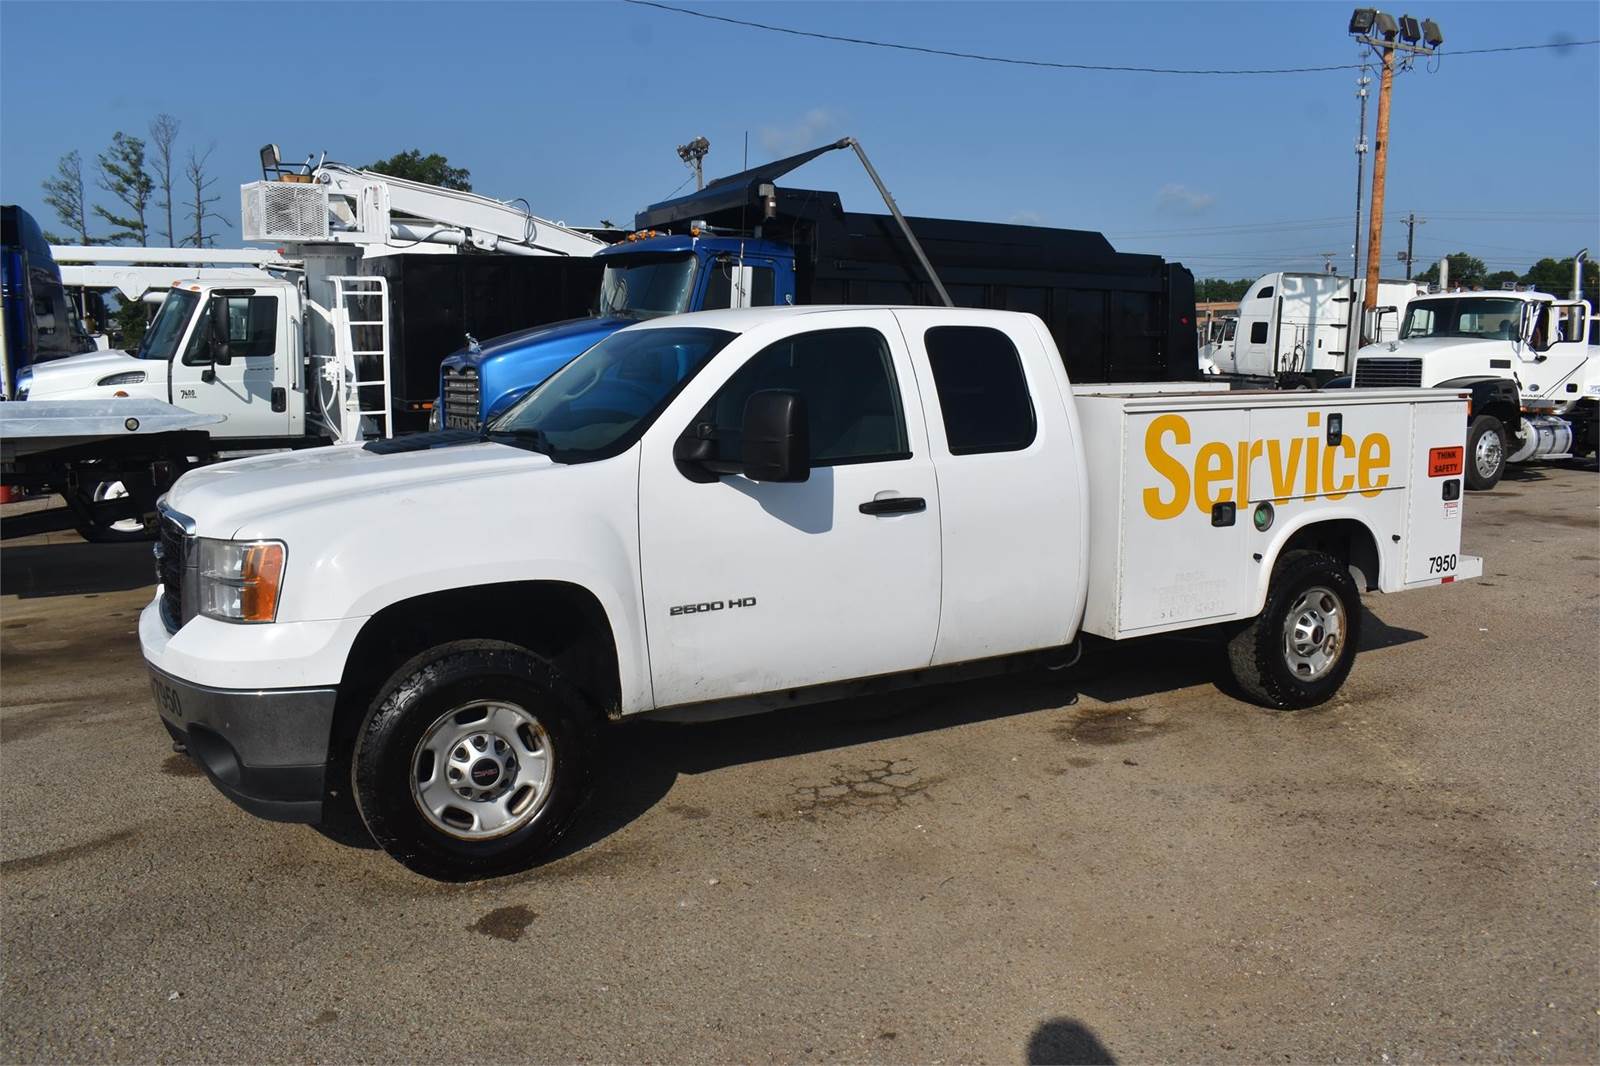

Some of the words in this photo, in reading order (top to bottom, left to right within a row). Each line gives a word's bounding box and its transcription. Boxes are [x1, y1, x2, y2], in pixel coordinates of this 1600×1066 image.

[1437, 451, 1456, 459] THINK
[1143, 412, 1391, 520] Service
[1434, 464, 1457, 473] SAFETY
[1429, 553, 1457, 574] 7950
[728, 597, 756, 608] HD
